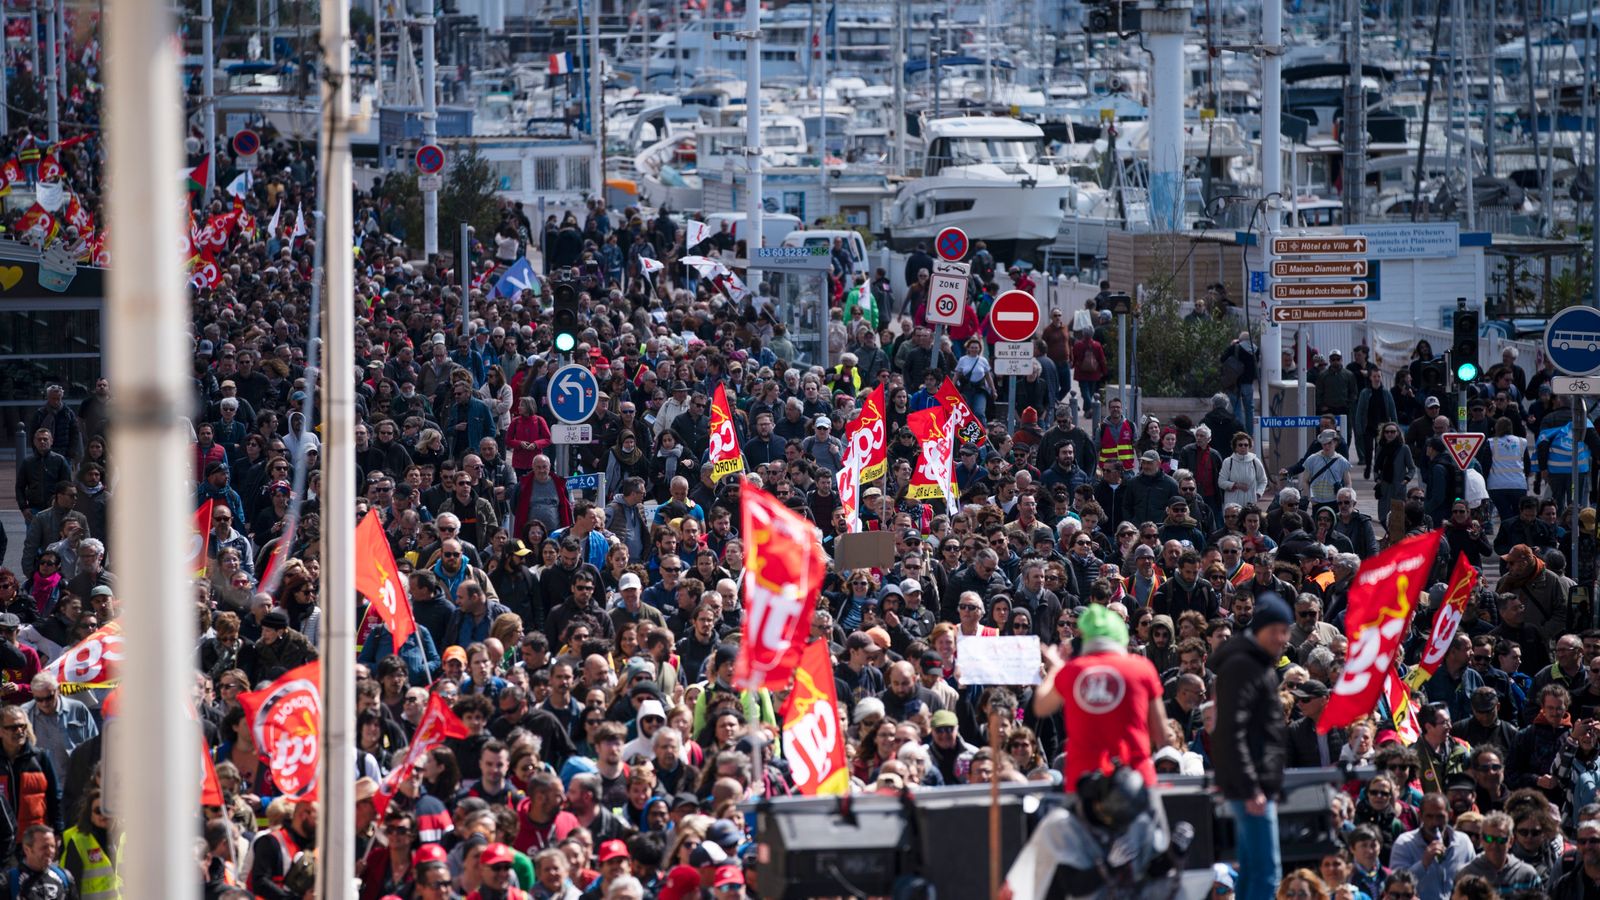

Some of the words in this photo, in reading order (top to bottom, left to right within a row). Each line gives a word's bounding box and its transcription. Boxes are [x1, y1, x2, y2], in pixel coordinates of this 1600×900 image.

[1399, 229, 1411, 237] des
[1301, 242, 1320, 250] Hôtel
[1322, 242, 1330, 250] de
[1333, 242, 1349, 250] Ville
[1368, 238, 1399, 246] ssionnels
[760, 248, 771, 257] 83
[772, 248, 784, 257] 60
[785, 248, 796, 257] 82
[1289, 265, 1313, 273] Maison
[1314, 264, 1351, 273] Diamantée
[939, 280, 960, 290] ZONE
[1289, 287, 1305, 295] Musée
[1306, 287, 1314, 295] des
[1314, 287, 1330, 295] Docks
[1330, 287, 1351, 295] Romains
[940, 300, 954, 311] 30
[1303, 310, 1317, 318] Musée
[1318, 310, 1338, 318] d'Histoire
[1262, 418, 1282, 427] Ville
[1284, 417, 1295, 426] de
